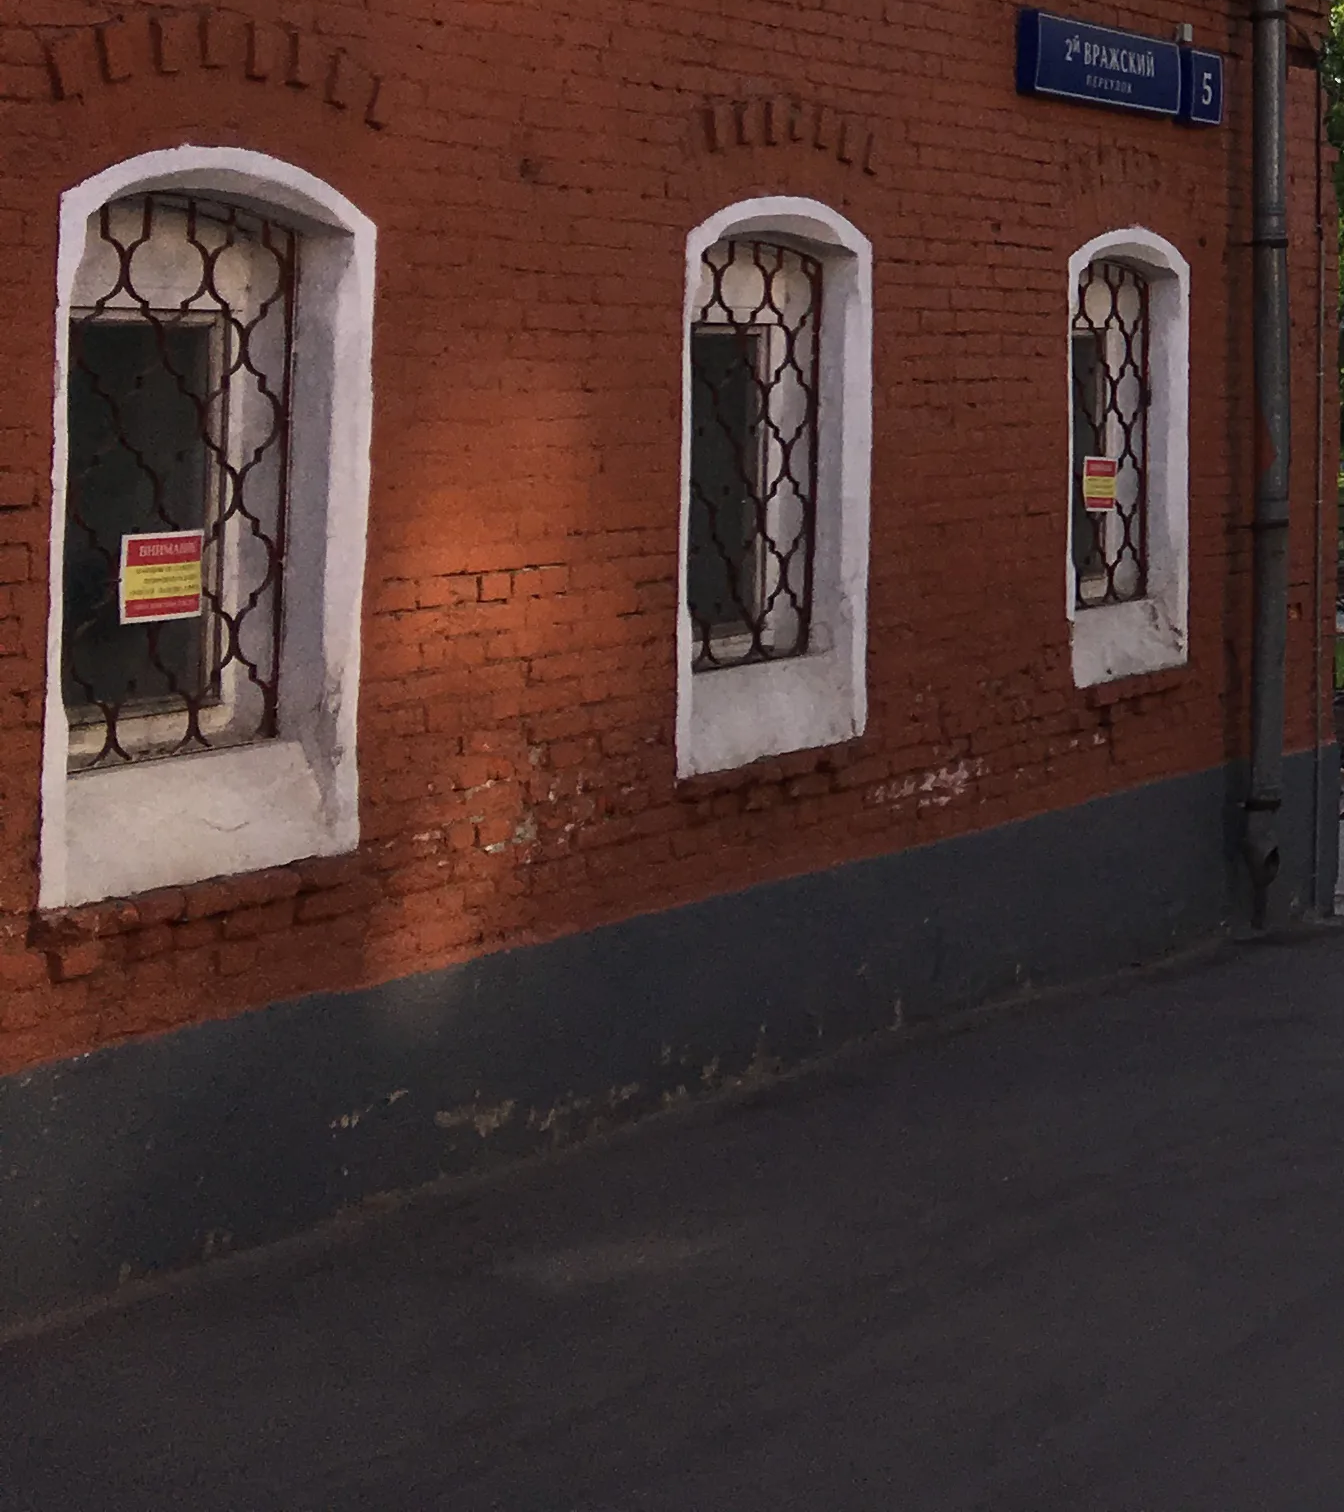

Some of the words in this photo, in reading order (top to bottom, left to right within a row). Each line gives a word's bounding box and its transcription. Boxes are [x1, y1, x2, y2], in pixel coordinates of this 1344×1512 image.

[1084, 41, 1155, 77] ВРАЖСКИЙ
[1086, 74, 1132, 93] ПЕРЕУЛОК
[1201, 71, 1214, 106] 5
